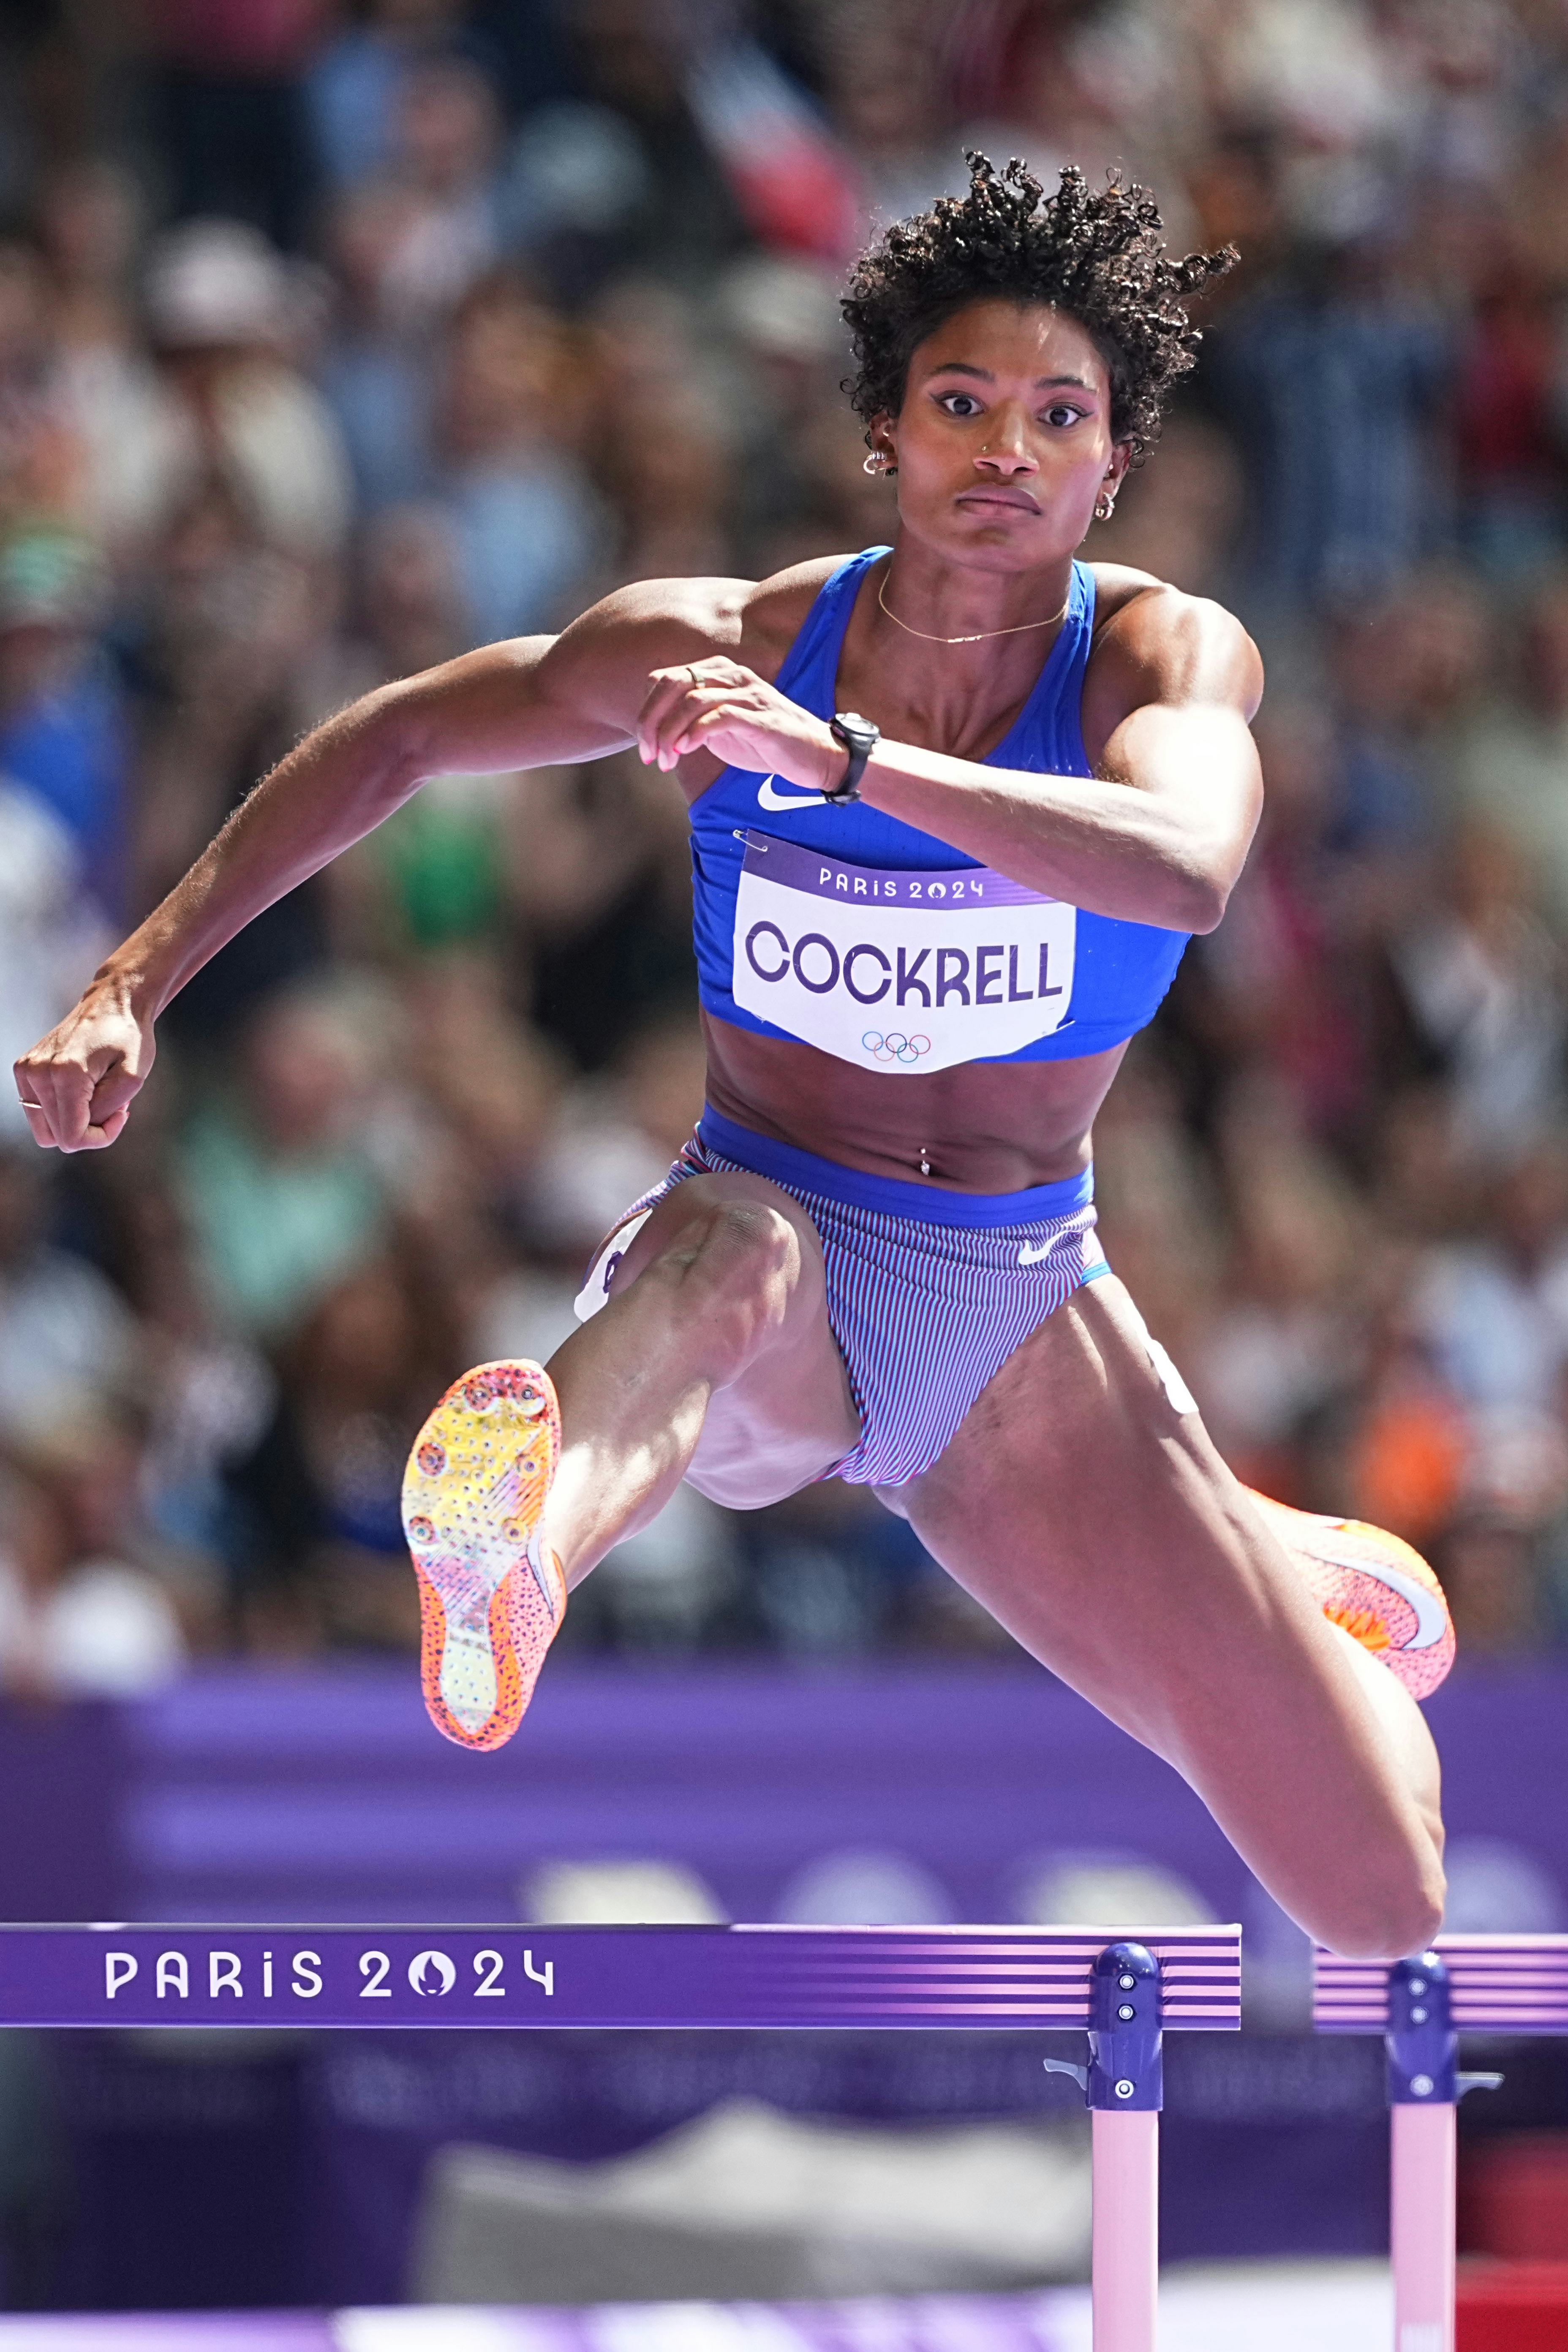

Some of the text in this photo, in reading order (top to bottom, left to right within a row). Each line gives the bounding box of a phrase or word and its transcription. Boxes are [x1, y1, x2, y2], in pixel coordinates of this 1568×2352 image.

[909, 879, 984, 899] 2024
[745, 920, 1063, 1008] COCKRELL
[359, 1949, 554, 1997] 2024
